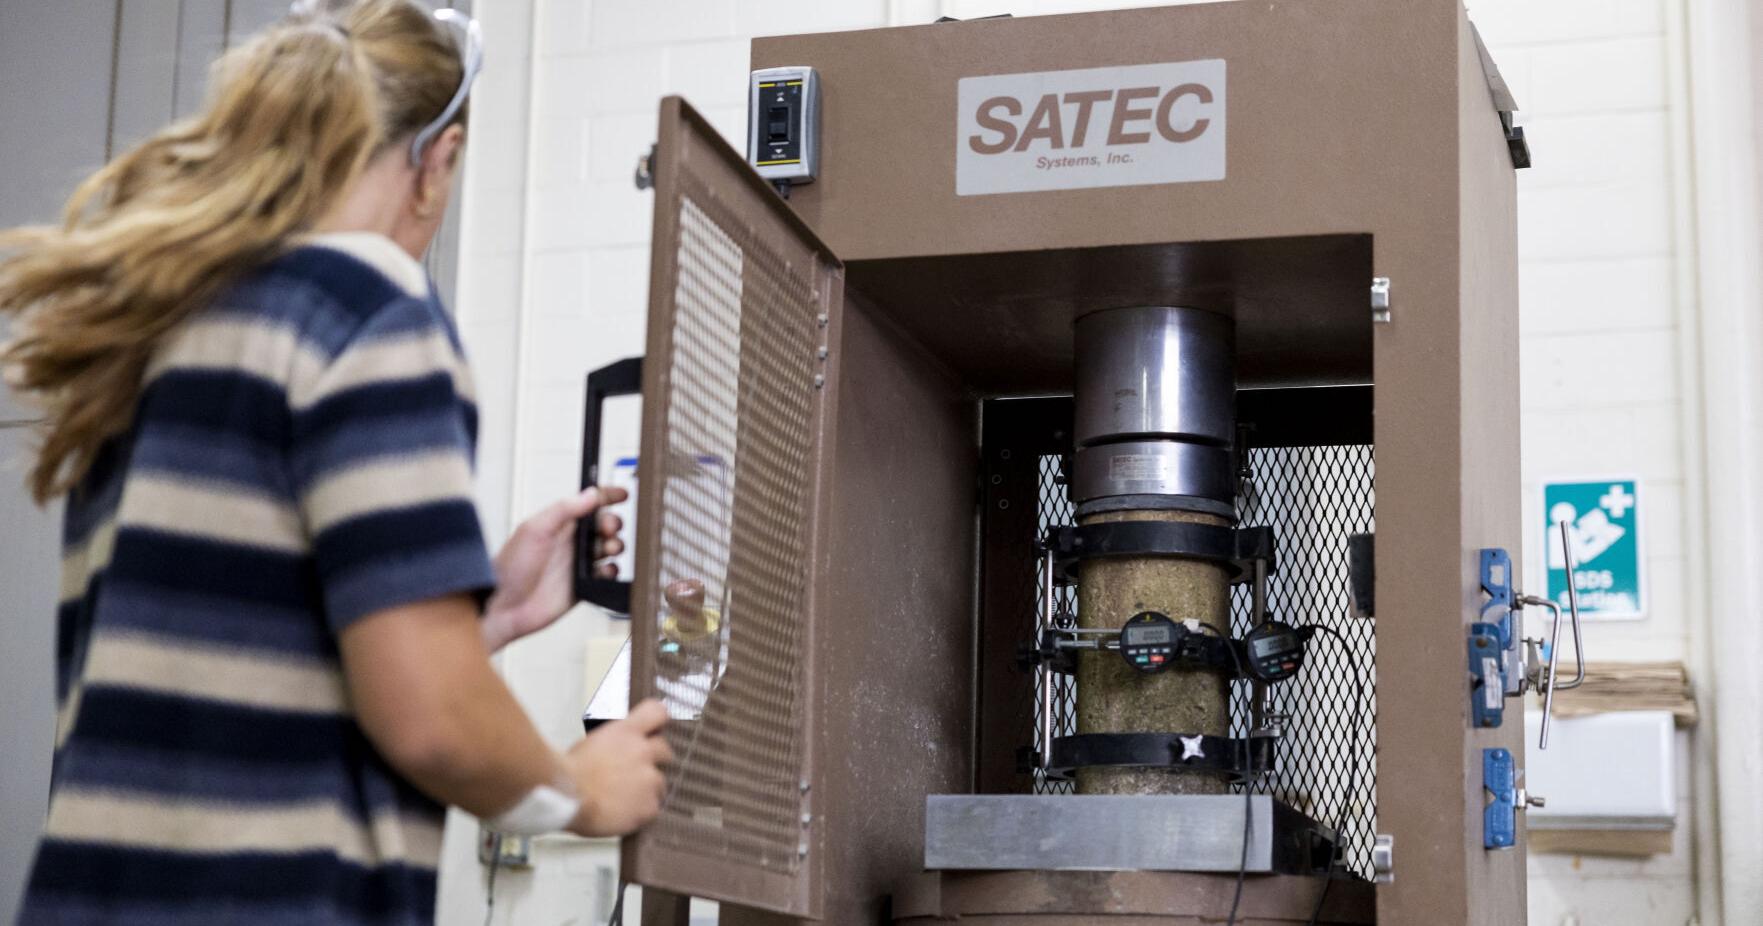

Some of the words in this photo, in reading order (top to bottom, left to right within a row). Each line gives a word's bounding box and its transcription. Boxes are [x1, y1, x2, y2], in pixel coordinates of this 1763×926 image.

[968, 82, 1214, 155] SATEC
[1036, 154, 1101, 171] Systems,
[1106, 152, 1134, 165] Inc.
